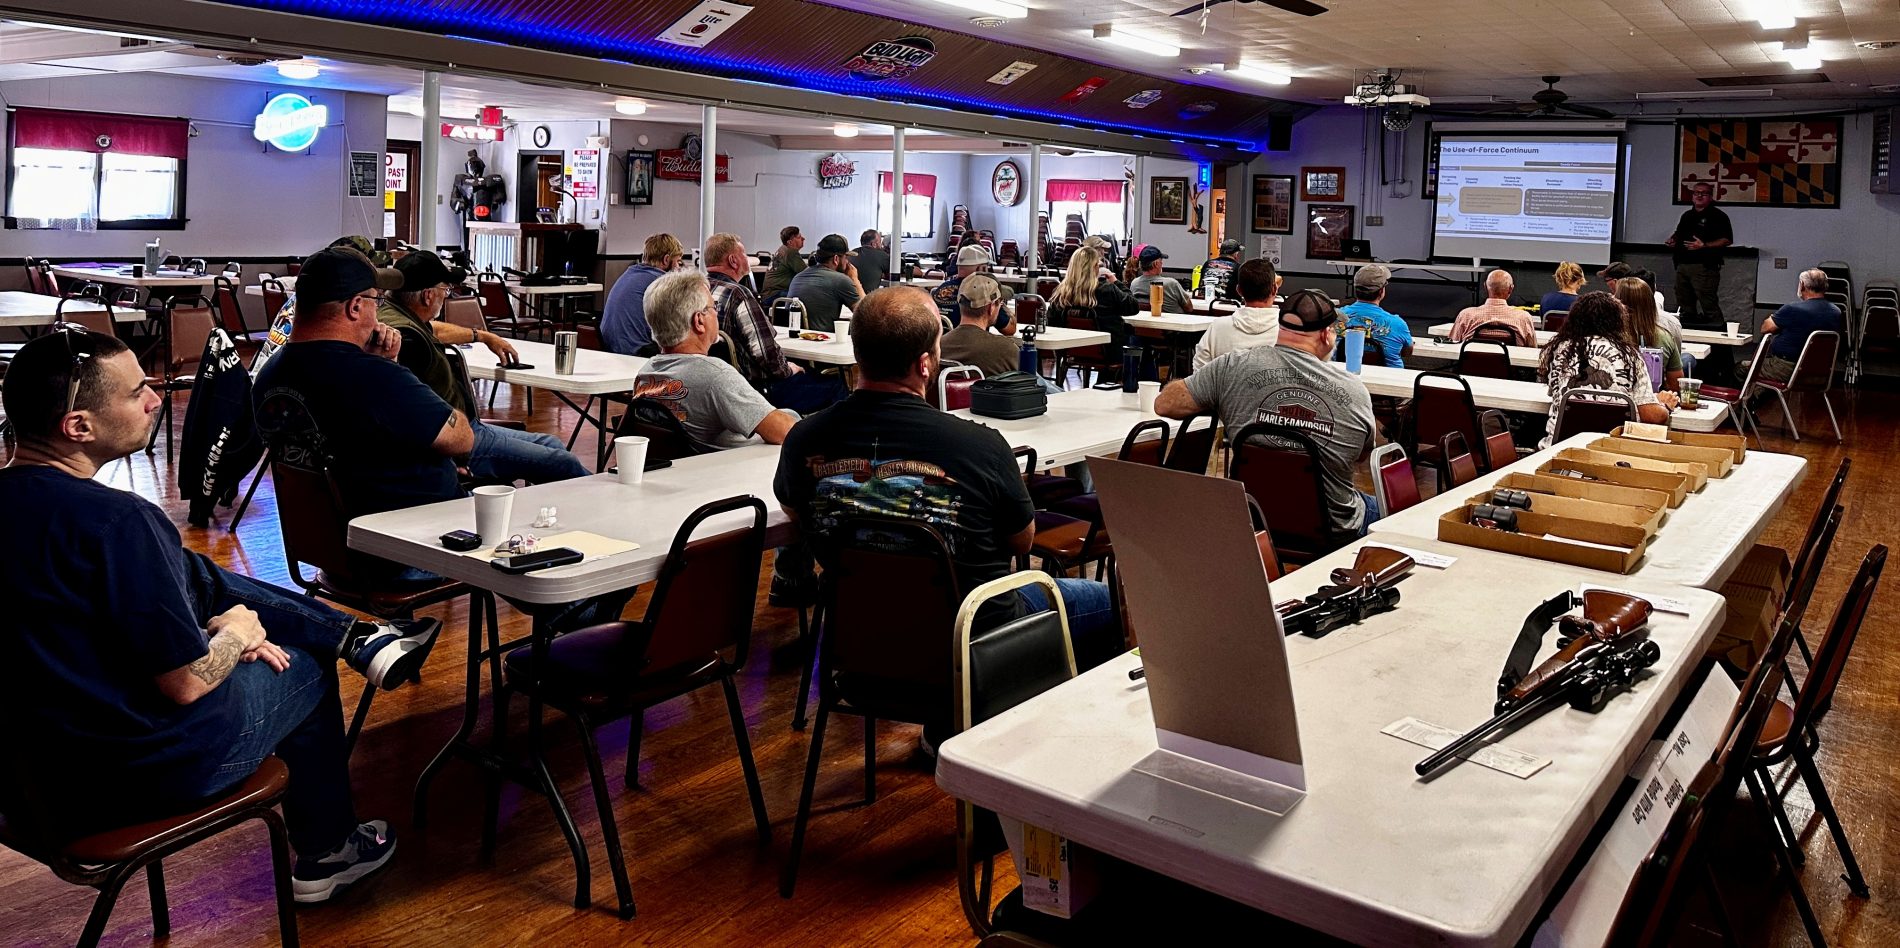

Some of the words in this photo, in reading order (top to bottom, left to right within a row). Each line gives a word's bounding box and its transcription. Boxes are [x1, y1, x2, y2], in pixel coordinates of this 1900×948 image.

[699, 14, 723, 24] Lite
[866, 42, 903, 58] BUD
[896, 47, 934, 66] LIGHT
[449, 125, 496, 140] ATM
[1452, 146, 1499, 154] Use-of-Force
[1500, 146, 1539, 154] Continuum
[385, 154, 393, 166] O
[387, 168, 405, 178] PAST
[385, 179, 402, 189] OINT
[1276, 391, 1321, 406] GENUINE
[1259, 412, 1332, 435] HARLEY-DAVIDSON
[817, 459, 866, 477] BATTLEFIELD
[876, 460, 941, 479] HARLEY-DAVIDSON
